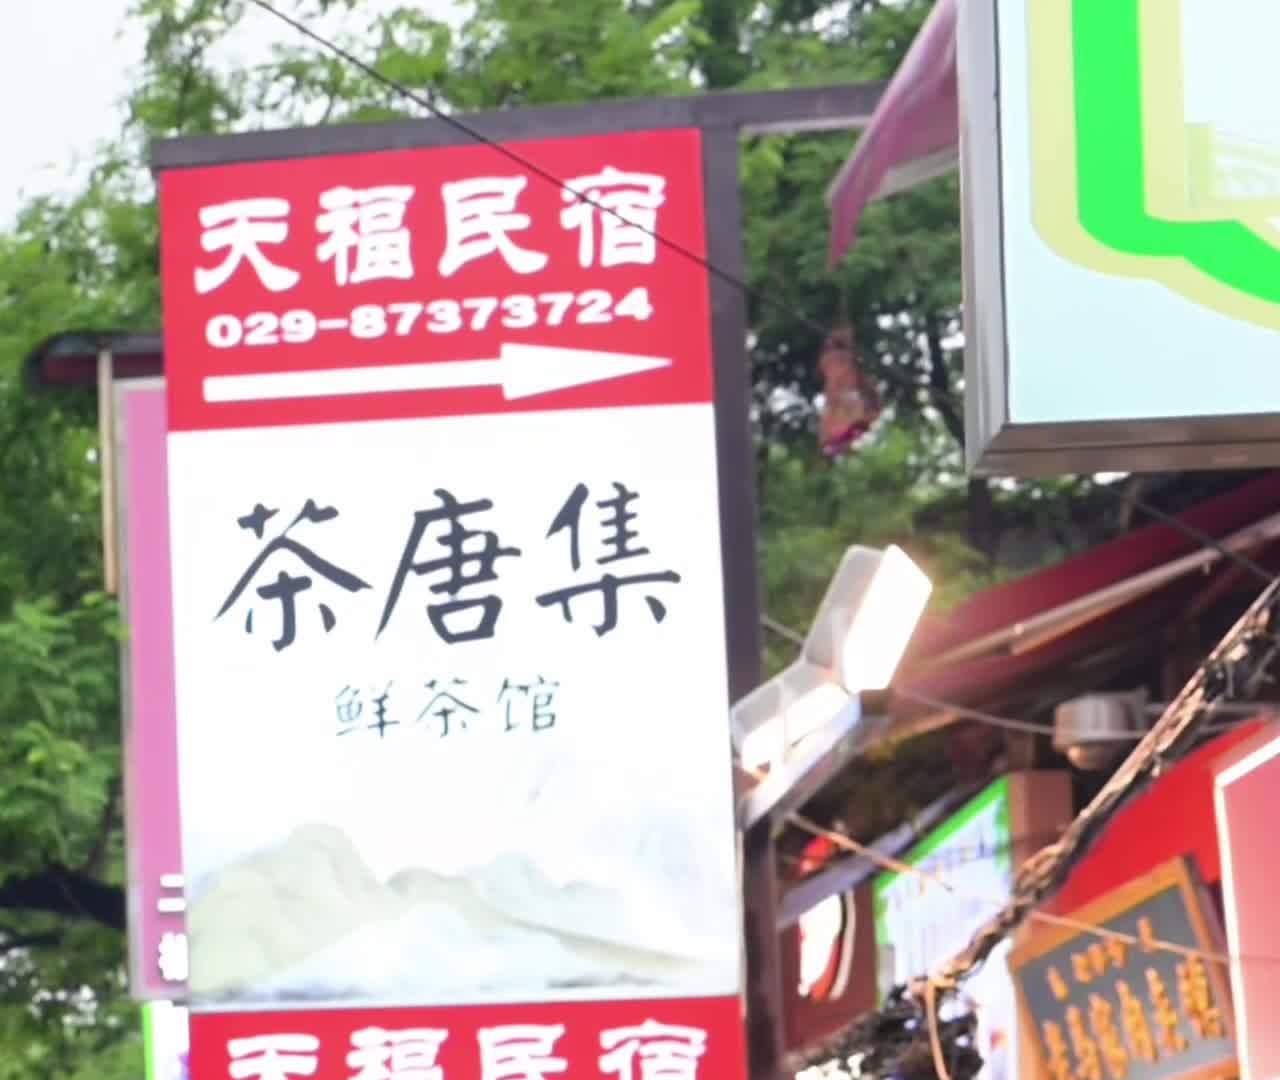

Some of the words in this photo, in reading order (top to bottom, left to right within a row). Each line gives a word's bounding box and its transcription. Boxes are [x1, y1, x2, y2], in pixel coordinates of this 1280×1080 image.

[194, 165, 666, 294] 天福民宿
[204, 287, 654, 349] 029-87373724
[213, 481, 682, 652] 茶唐集
[333, 675, 560, 738] 鲜茶馆
